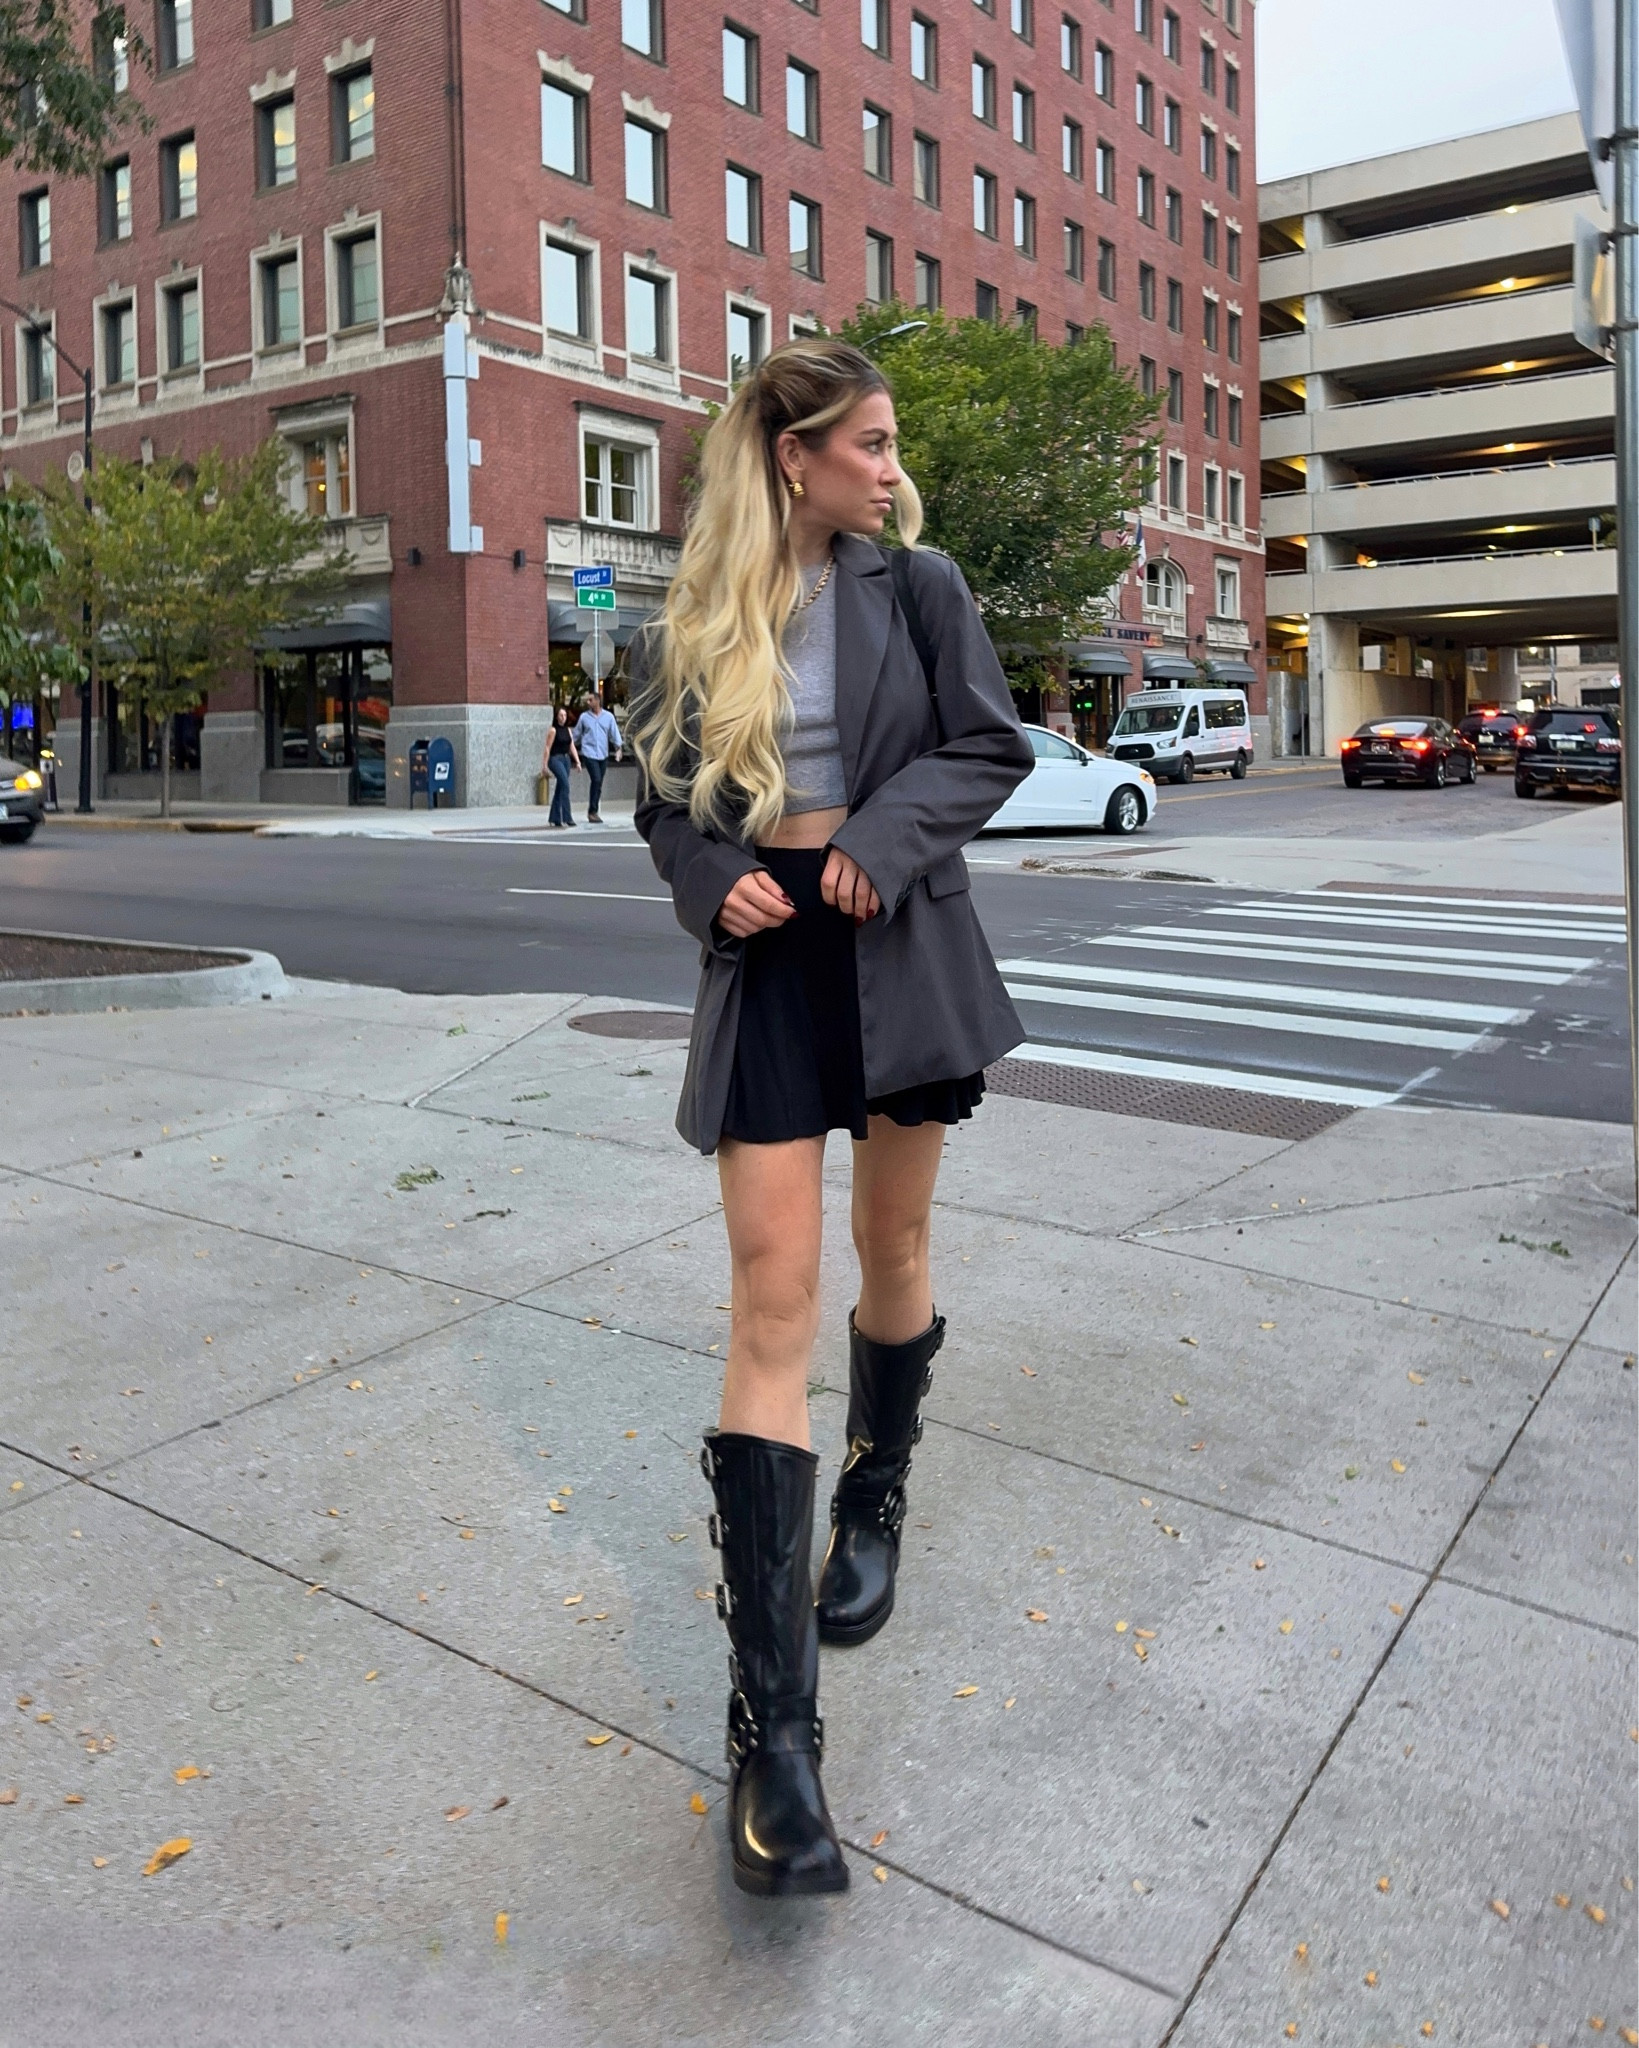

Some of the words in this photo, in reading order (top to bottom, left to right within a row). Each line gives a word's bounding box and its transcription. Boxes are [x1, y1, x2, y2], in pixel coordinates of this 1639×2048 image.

[578, 572, 600, 584] Locust
[1117, 629, 1151, 641] SAVERY
[1131, 694, 1175, 704] RENAISSANCE
